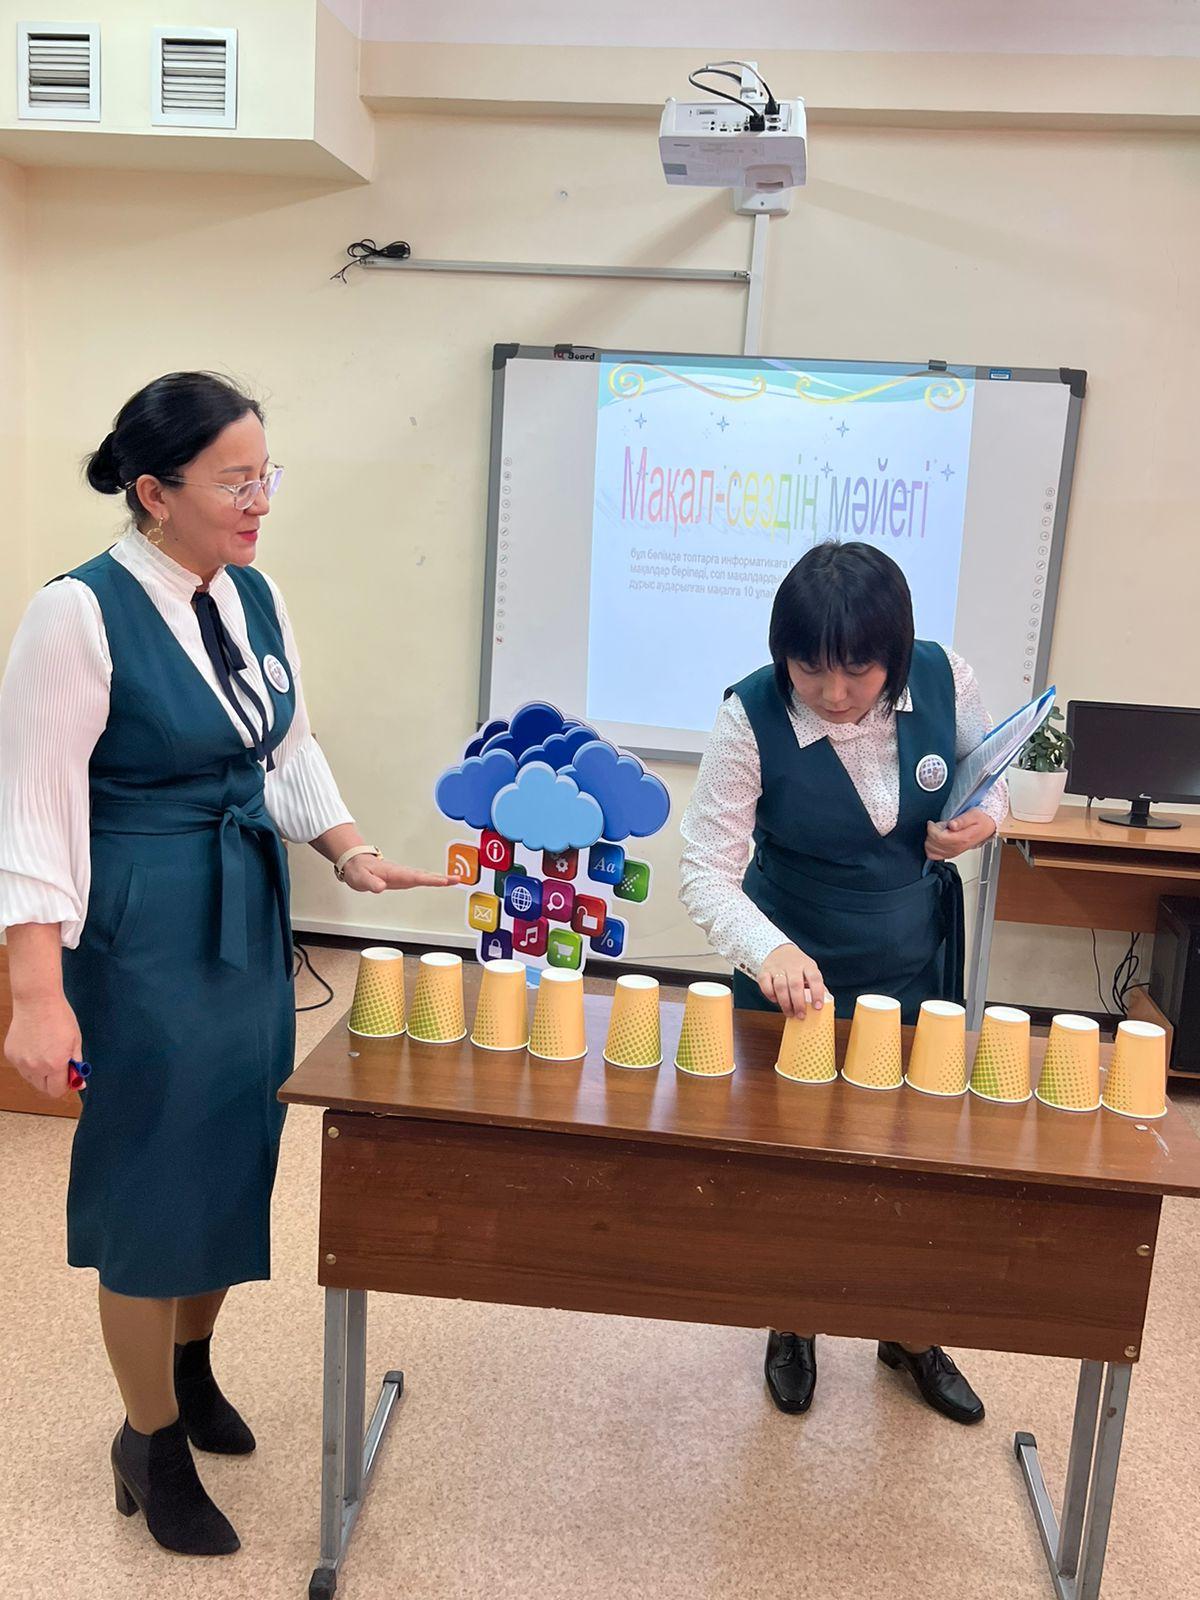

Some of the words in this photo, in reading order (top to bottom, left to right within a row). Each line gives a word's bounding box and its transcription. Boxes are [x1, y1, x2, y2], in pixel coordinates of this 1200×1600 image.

[621, 445, 819, 545] Мақал-сөздің
[828, 457, 930, 539] мәйегі
[744, 585, 754, 598] 10
[594, 857, 617, 874] Aa
